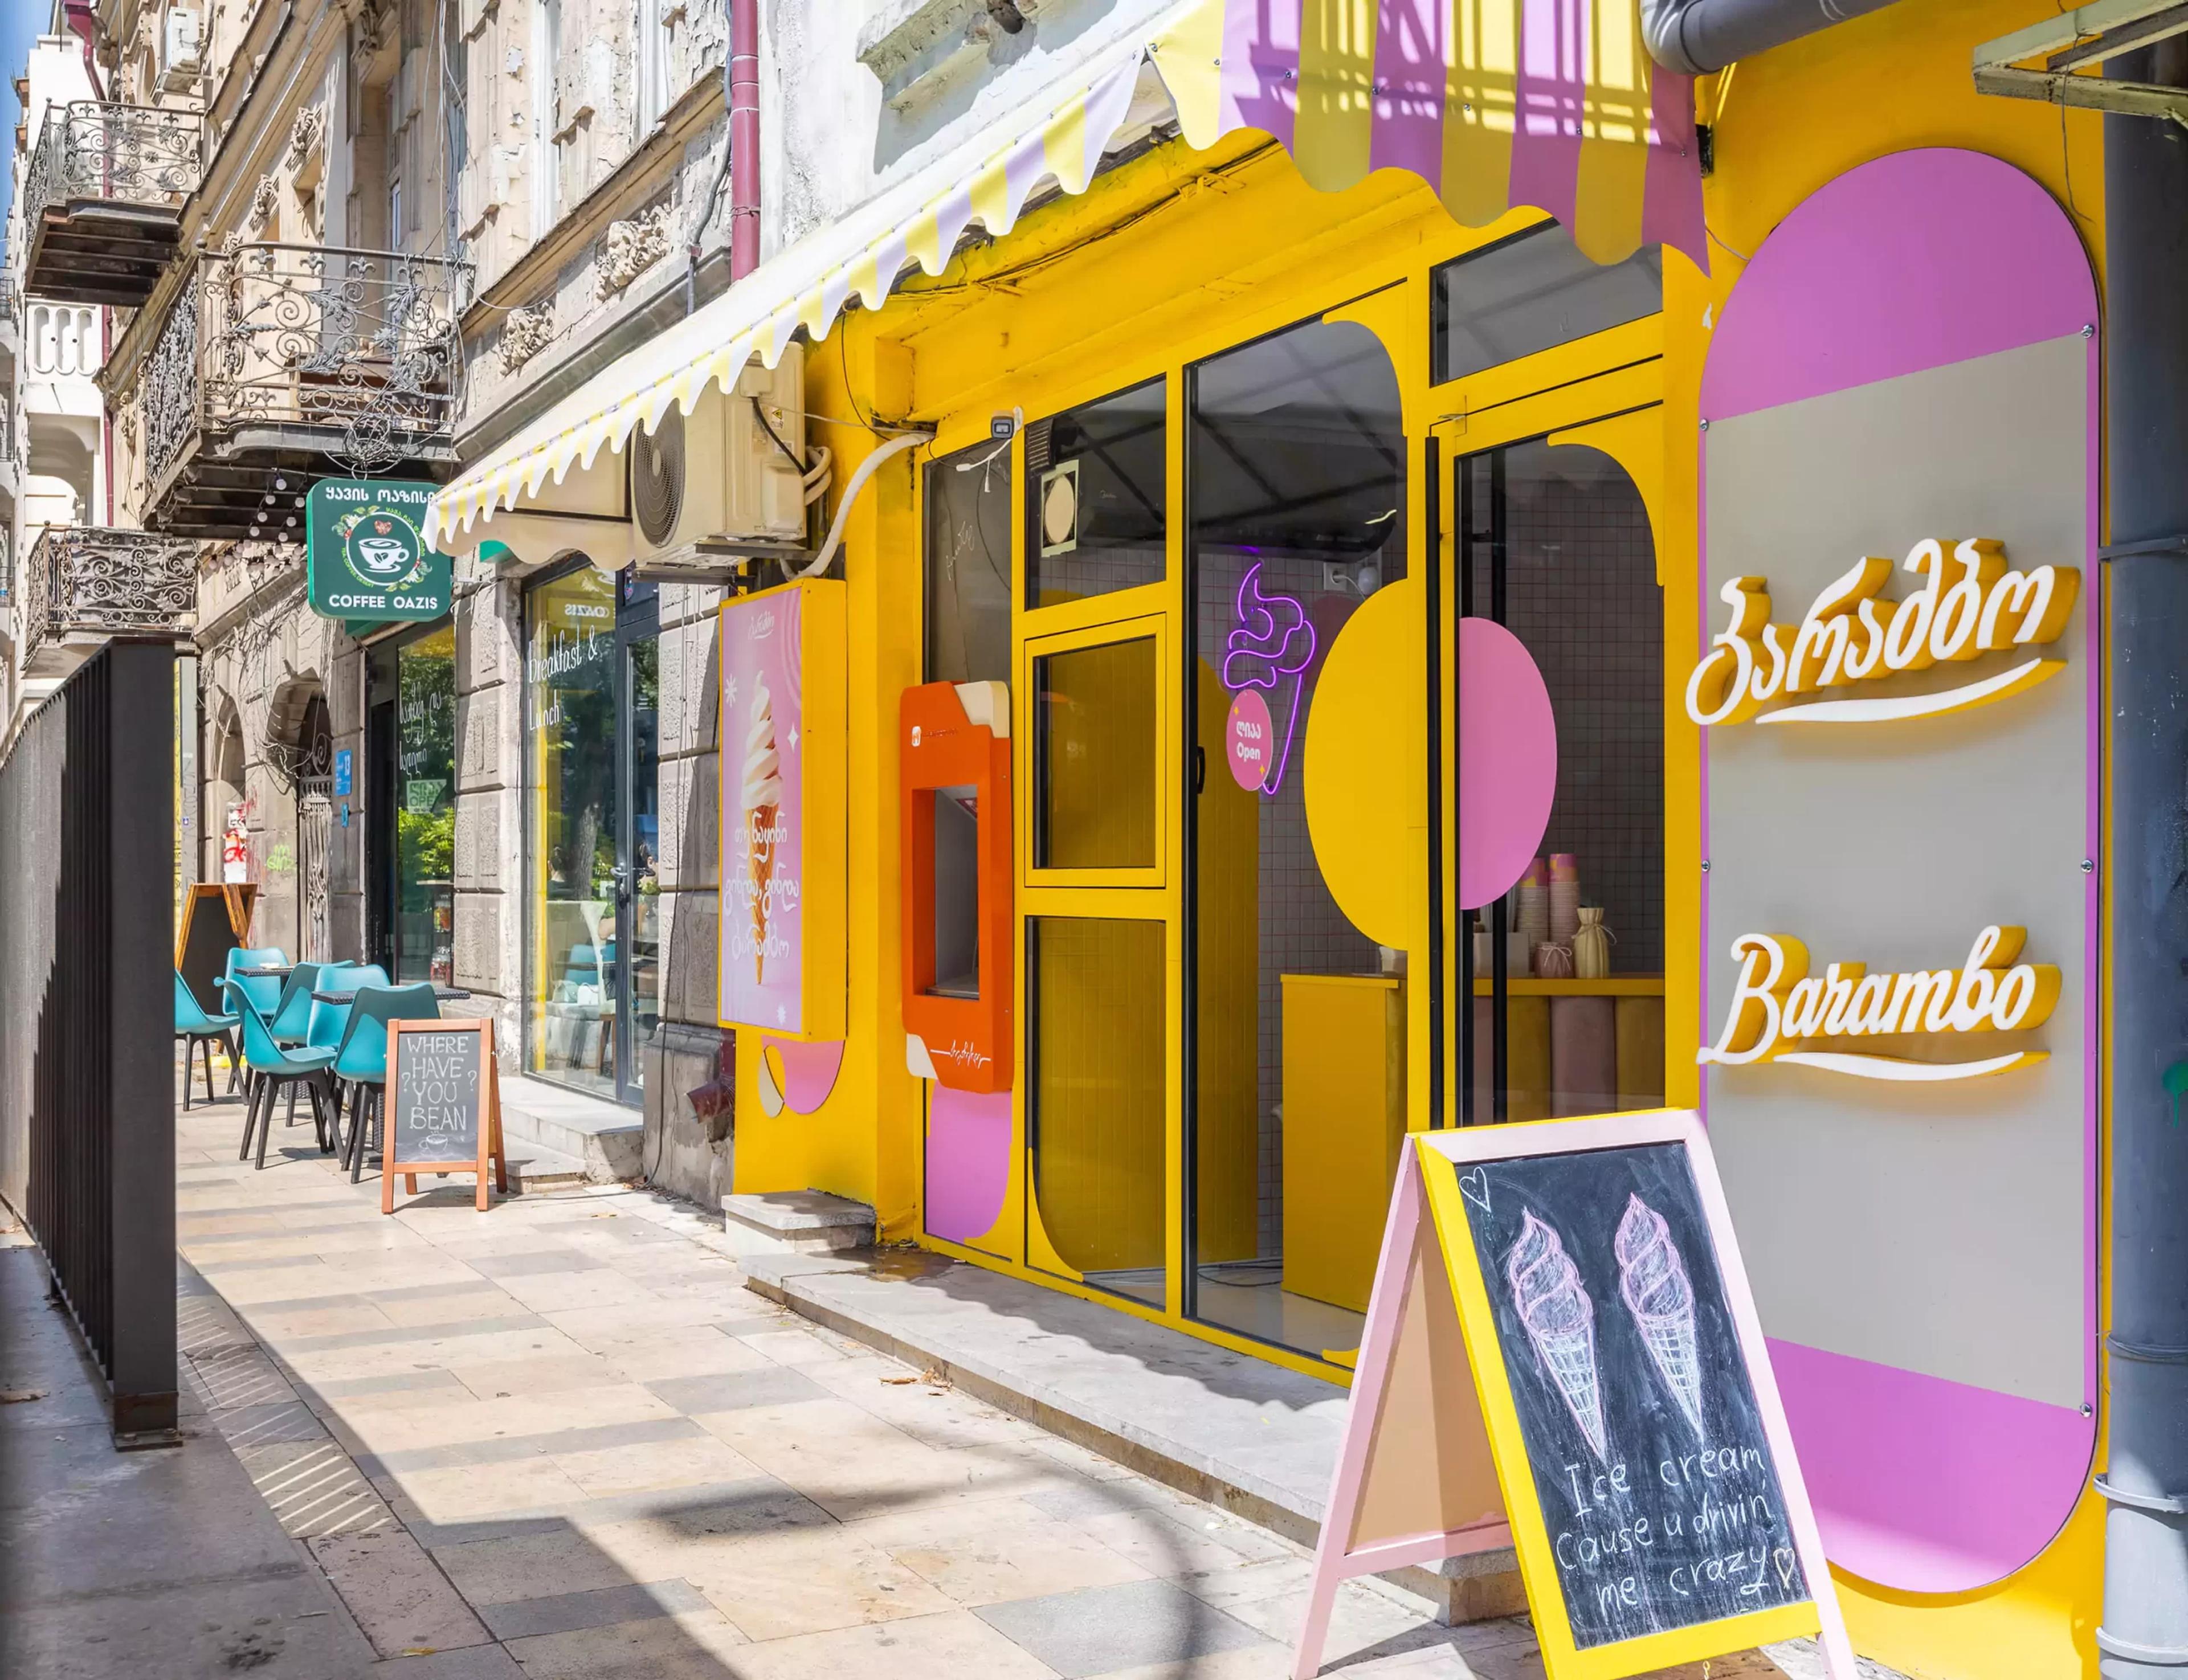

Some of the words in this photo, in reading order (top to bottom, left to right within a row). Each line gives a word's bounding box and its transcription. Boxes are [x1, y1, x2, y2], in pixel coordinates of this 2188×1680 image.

[326, 487, 369, 501] ყავის
[329, 595, 386, 608] COFFEE
[393, 596, 438, 610] OAZIS
[587, 625, 598, 661] &
[1685, 538, 2068, 725] ბარამბო
[529, 688, 560, 731] Lunch
[1236, 721, 1262, 739] ღიაა
[1236, 742, 1261, 762] Open
[410, 796, 434, 807] OPE
[1696, 925, 2051, 1065] Barambo
[407, 1036, 469, 1054] WHERE
[412, 1056, 464, 1079] HAVE
[413, 1082, 457, 1105] YOU
[409, 1105, 467, 1131] BEAN
[1565, 1463, 1631, 1517] Ice
[1556, 1518, 1654, 1570] Cause
[1663, 1513, 1684, 1536] u
[1595, 1576, 1638, 1620] me
[1669, 1545, 1769, 1596] crazy
